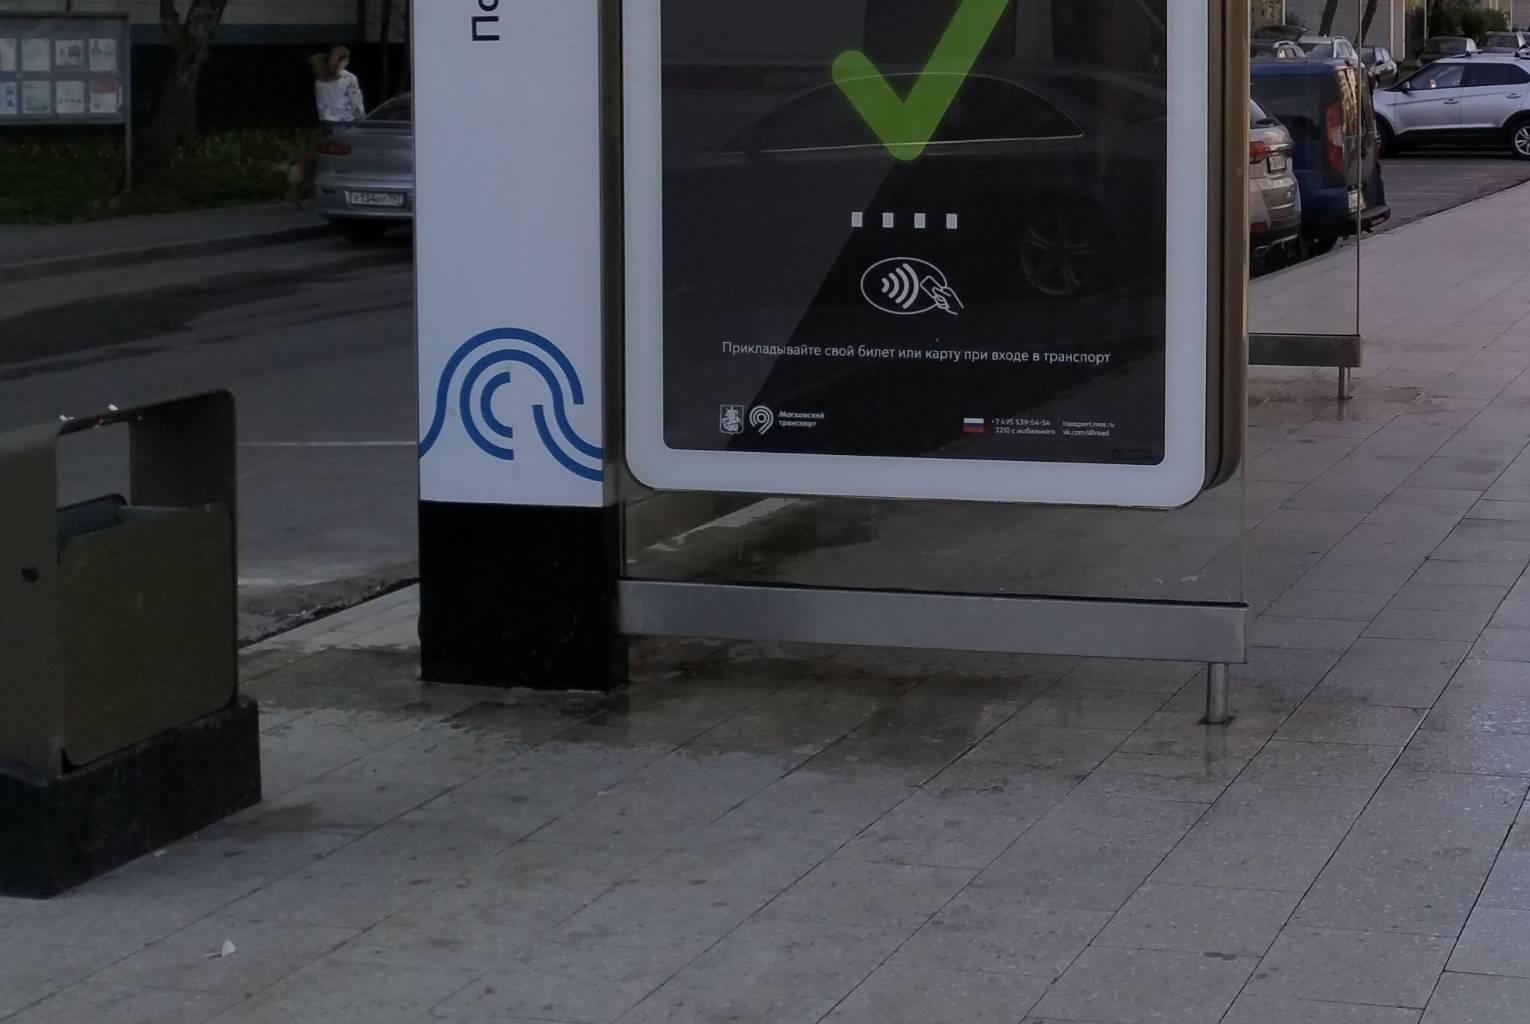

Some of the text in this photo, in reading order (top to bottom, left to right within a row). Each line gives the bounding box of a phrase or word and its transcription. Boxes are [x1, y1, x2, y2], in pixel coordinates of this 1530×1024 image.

[722, 341, 1111, 366] Прикладывайте свой билет или карту при входе в транспорт
